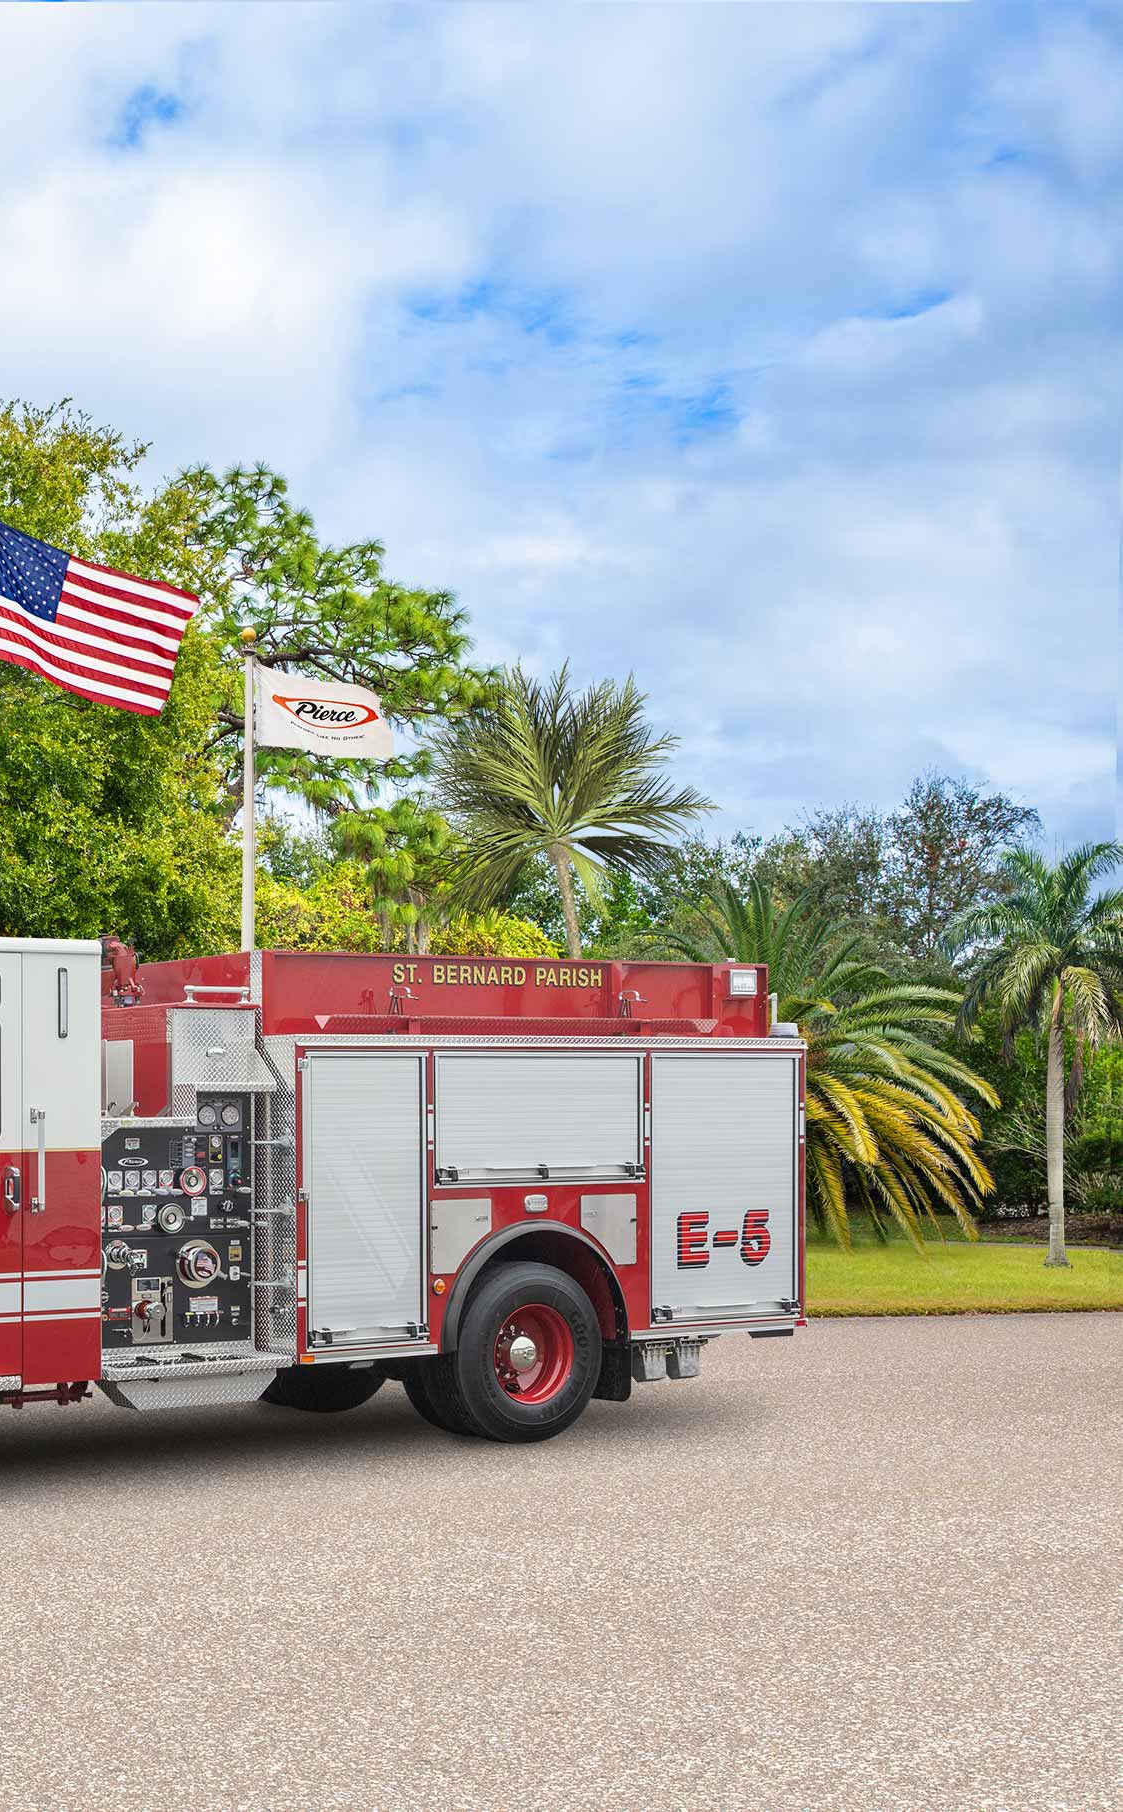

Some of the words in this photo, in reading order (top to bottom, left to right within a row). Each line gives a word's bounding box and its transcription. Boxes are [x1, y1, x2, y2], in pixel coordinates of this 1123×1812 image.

[295, 701, 358, 722] Pierce
[392, 963, 423, 985] ST.
[433, 964, 527, 987] BERNARD
[535, 966, 602, 988] PARISH
[676, 1208, 771, 1270] E-5
